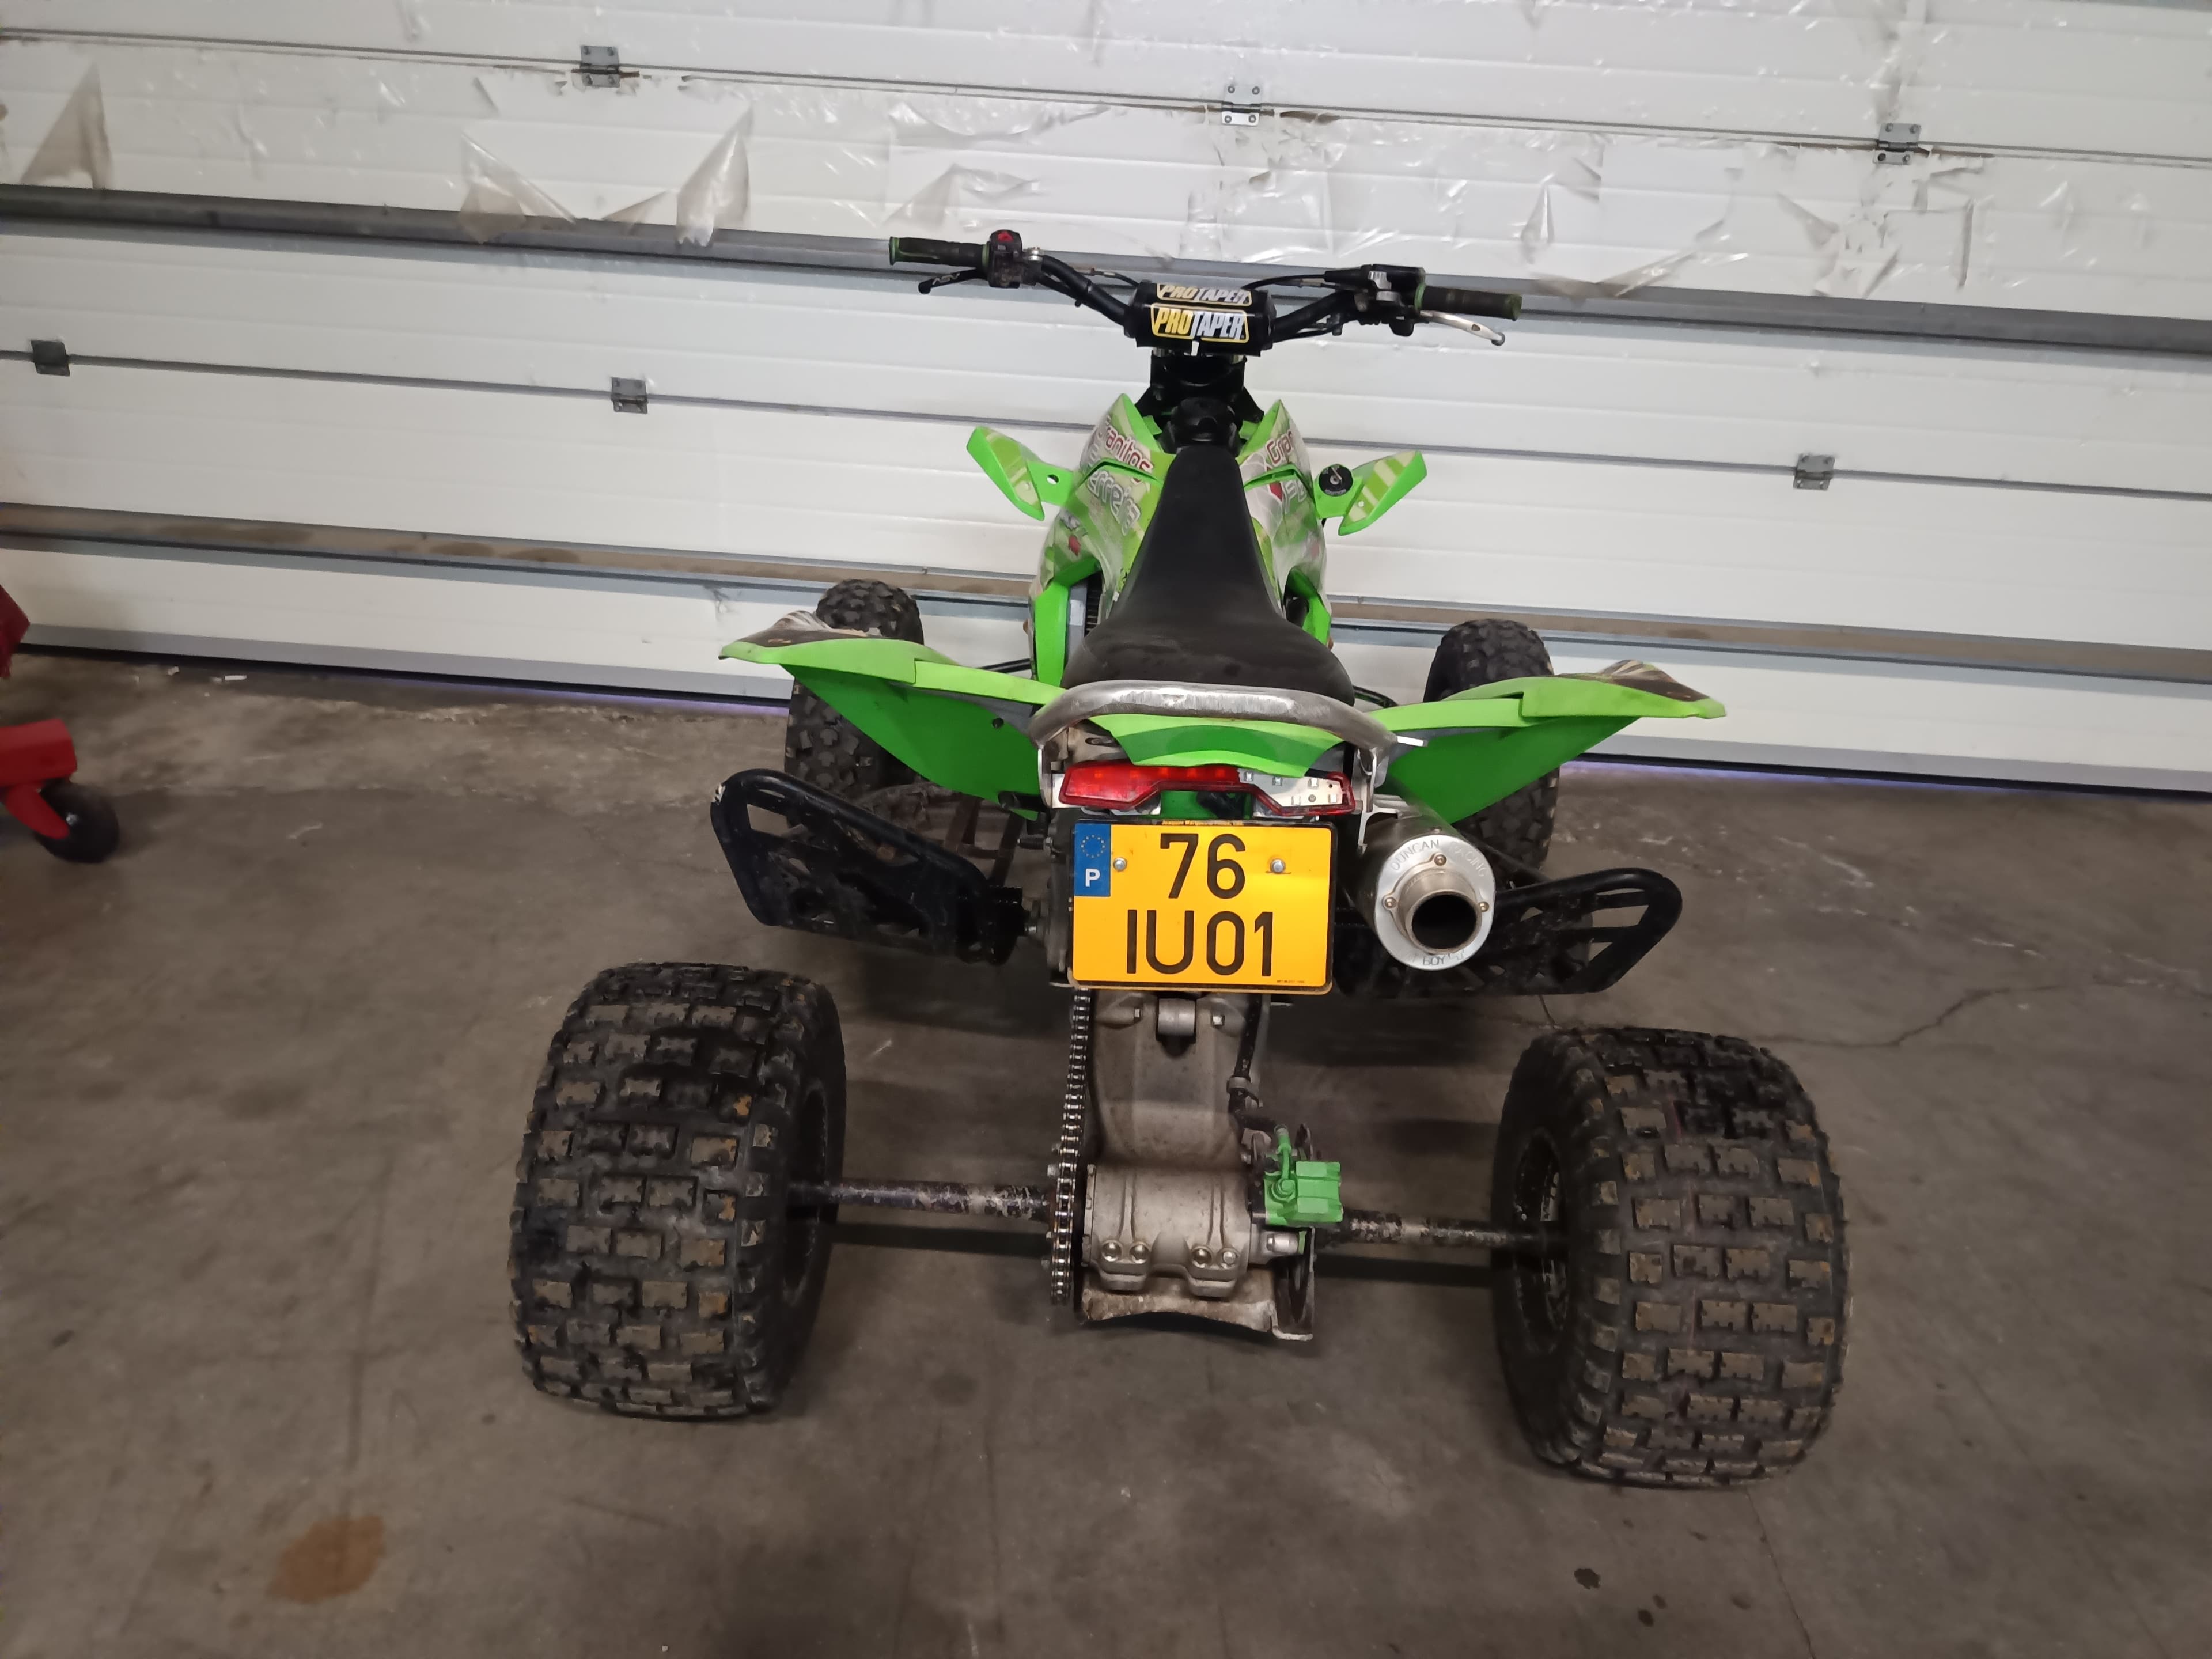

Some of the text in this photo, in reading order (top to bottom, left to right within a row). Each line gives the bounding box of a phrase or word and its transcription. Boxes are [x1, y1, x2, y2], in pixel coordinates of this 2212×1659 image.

[1154, 307, 1244, 340] PROTAPER
[1160, 833, 1246, 899] 76
[1391, 839, 1440, 871] DUNCAN
[1085, 869, 1100, 887] P
